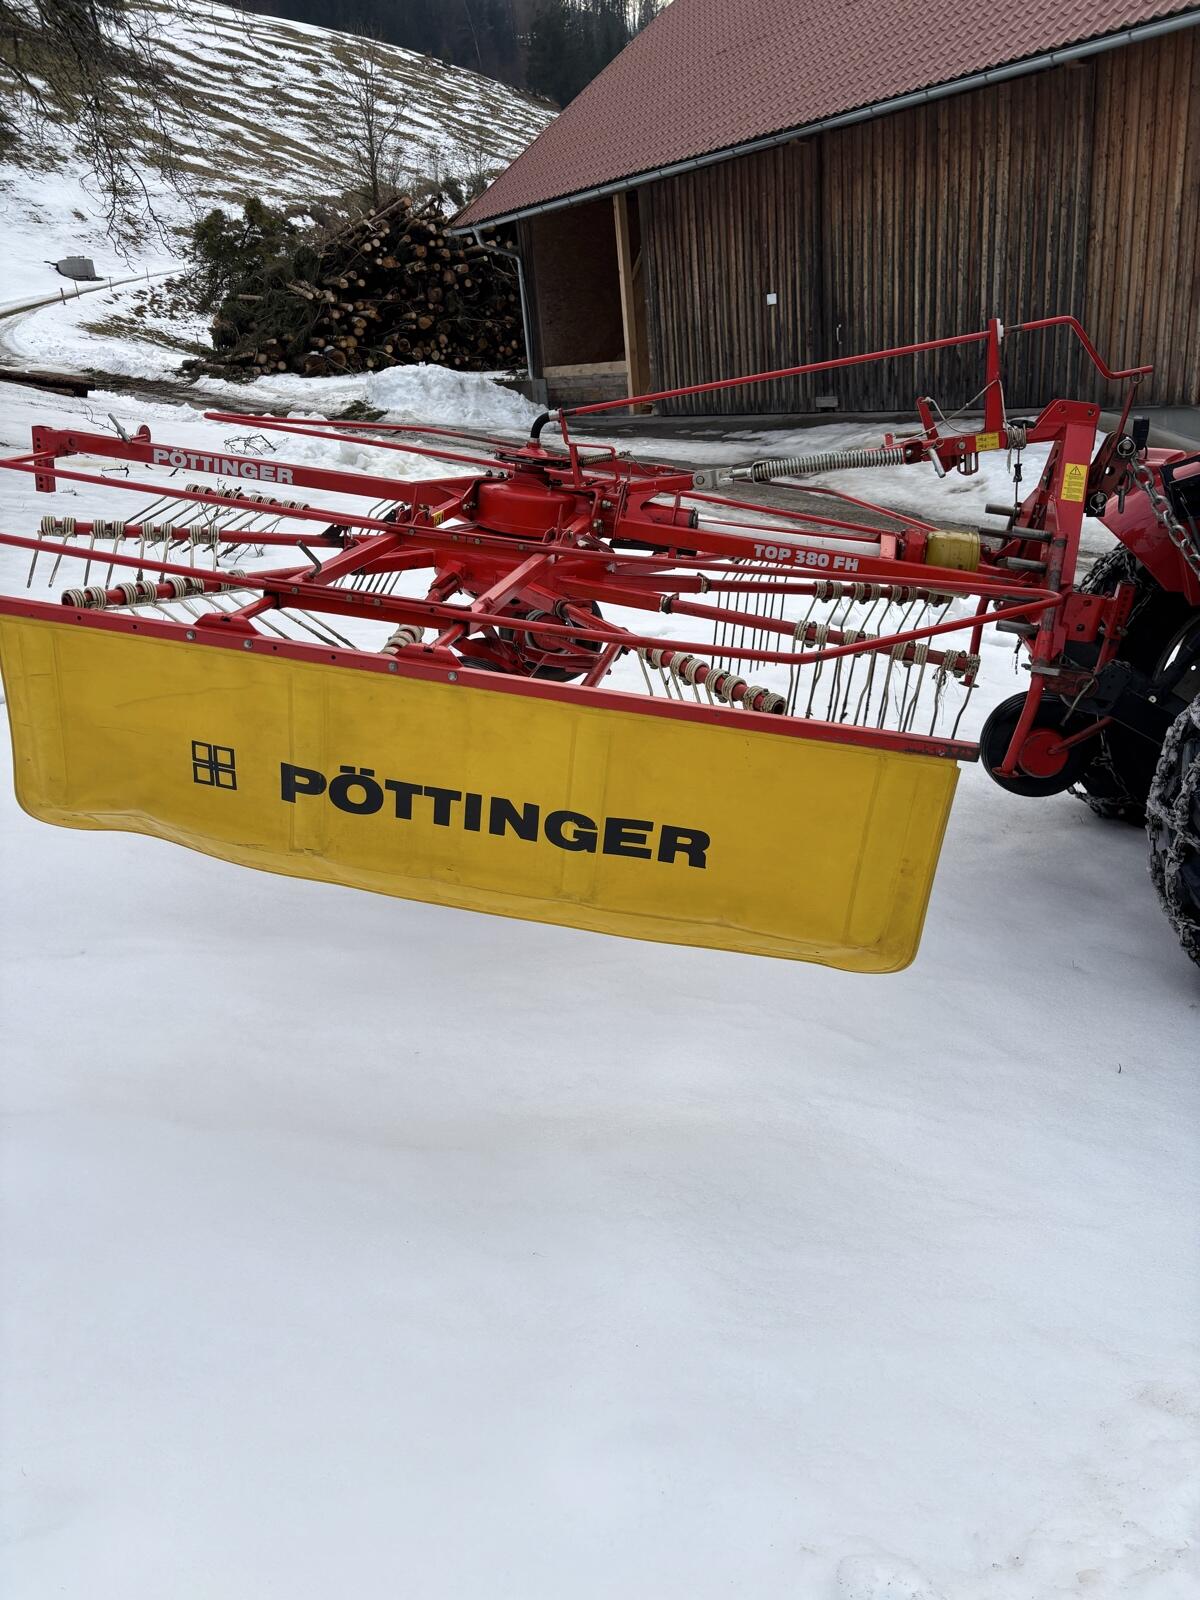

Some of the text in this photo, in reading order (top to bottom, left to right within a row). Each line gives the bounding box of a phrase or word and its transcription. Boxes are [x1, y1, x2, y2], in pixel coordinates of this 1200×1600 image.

[153, 448, 294, 484] PÖTTINGER
[754, 544, 859, 571] TOP 380 FH
[280, 762, 711, 869] PÖTTINGER
